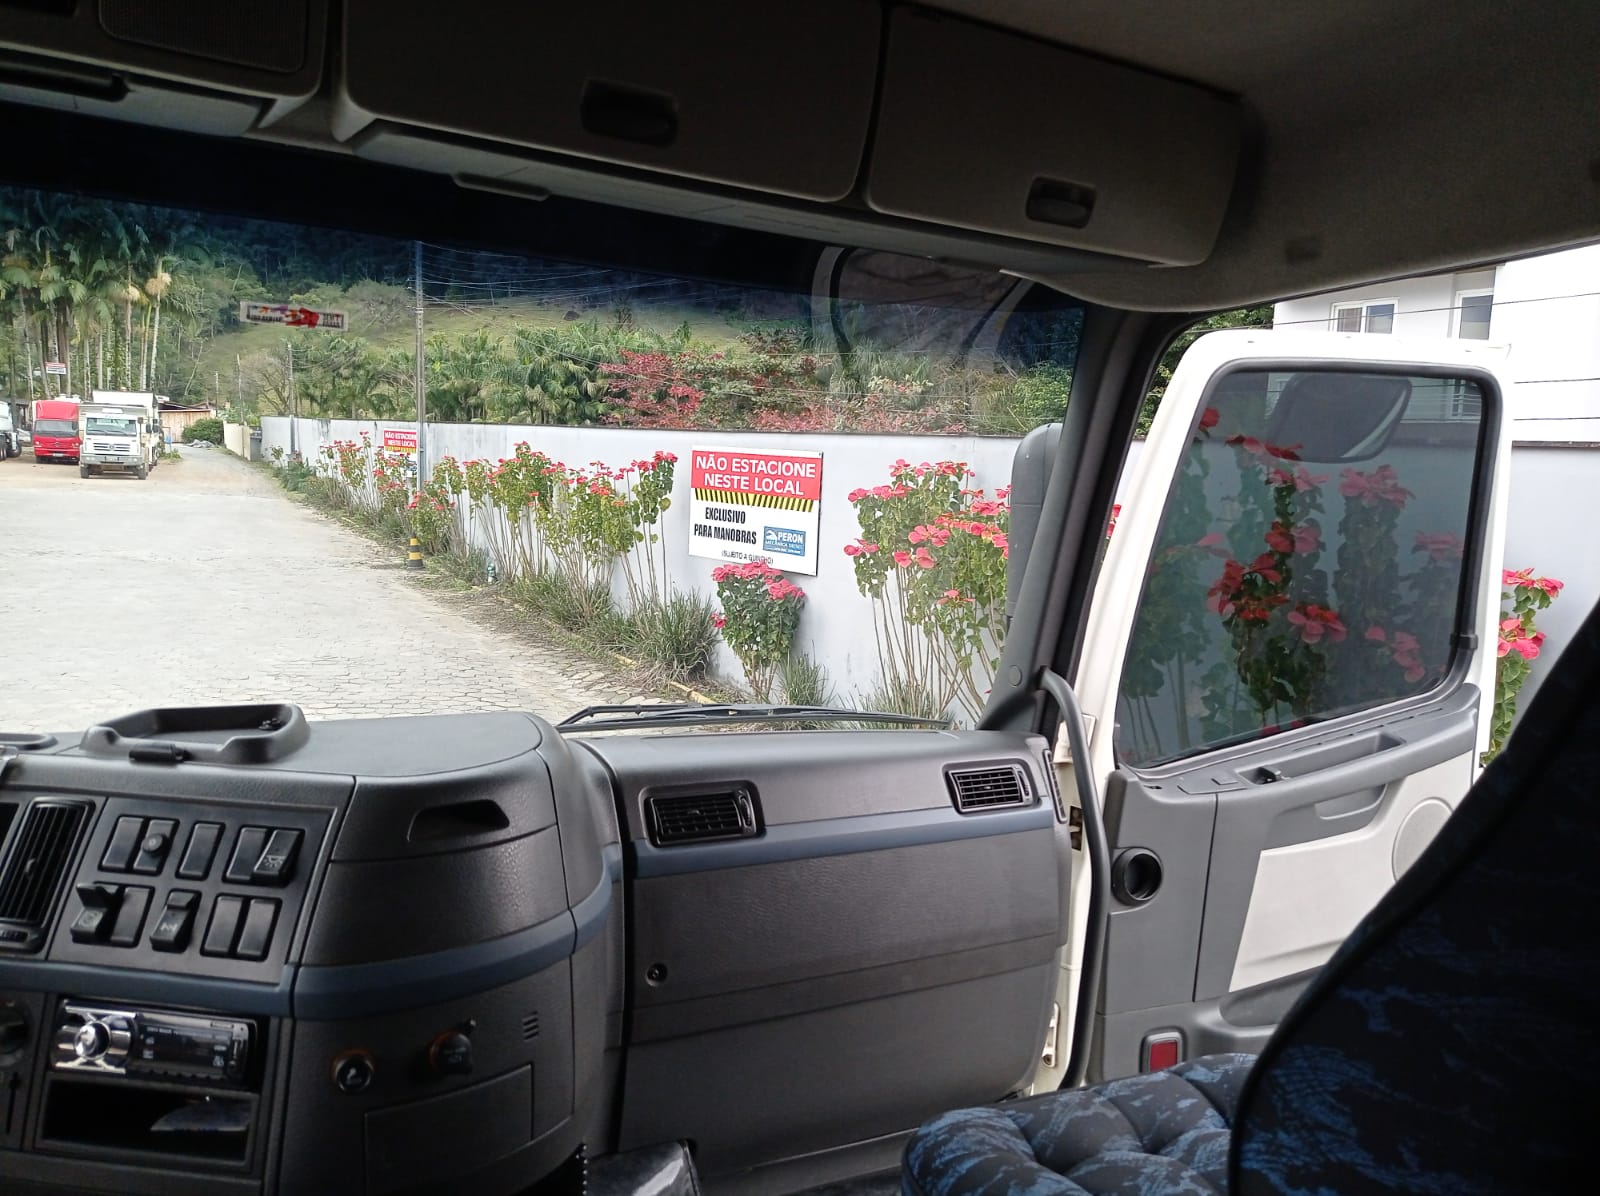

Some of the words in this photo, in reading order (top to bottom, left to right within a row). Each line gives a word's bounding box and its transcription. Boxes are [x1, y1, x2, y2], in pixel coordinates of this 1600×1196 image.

[696, 454, 727, 471] NÃO
[732, 458, 816, 478] ESTACIONE
[704, 473, 749, 490] NESTE
[755, 477, 804, 495] LOCAL
[705, 507, 746, 524] EXCLUSIVO
[694, 523, 712, 538] PARA
[713, 526, 757, 545] MANOBRAS
[777, 531, 804, 544] PERON
